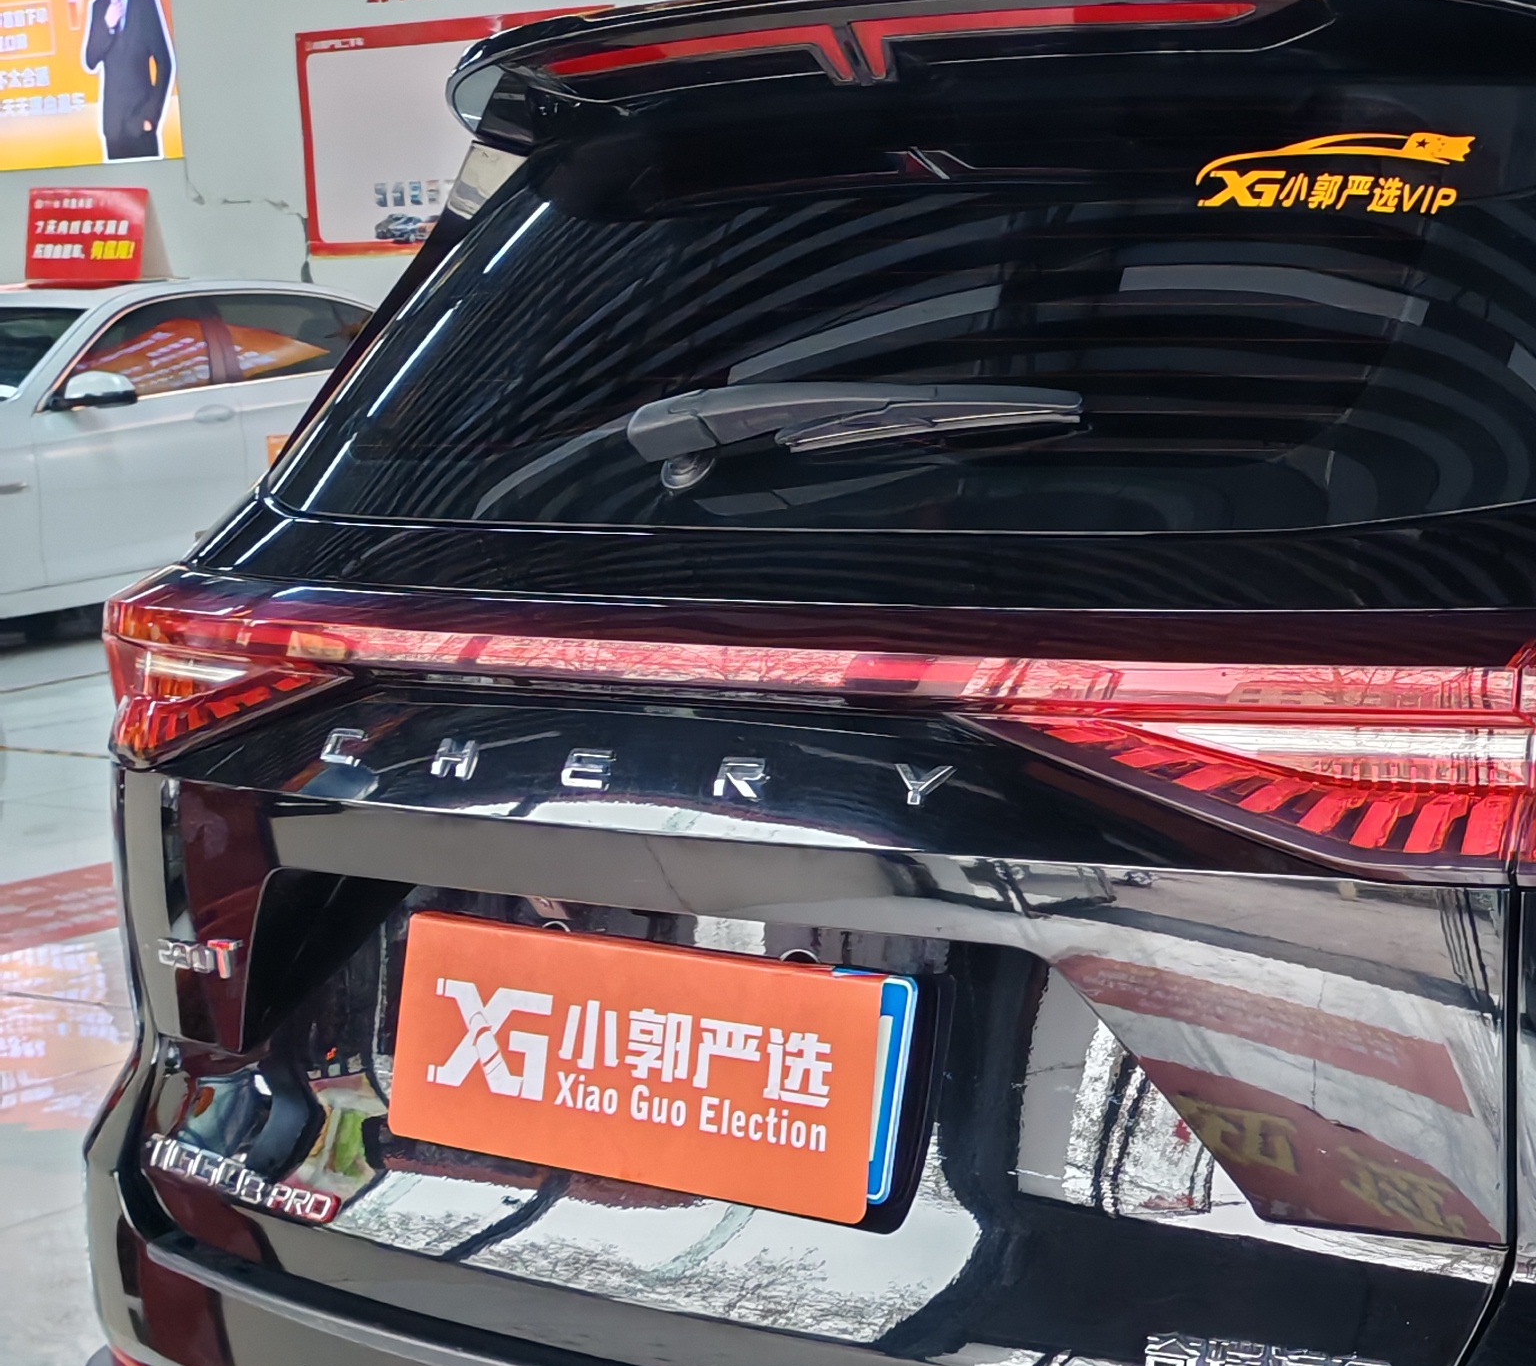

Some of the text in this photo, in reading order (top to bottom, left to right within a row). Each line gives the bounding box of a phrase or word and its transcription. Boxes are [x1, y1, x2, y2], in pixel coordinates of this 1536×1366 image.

[319, 728, 956, 807] CHERY
[426, 977, 833, 1108] XG 小郭严选
[553, 1070, 827, 1153] Xiao Guo Election
[267, 1182, 333, 1223] PRO
